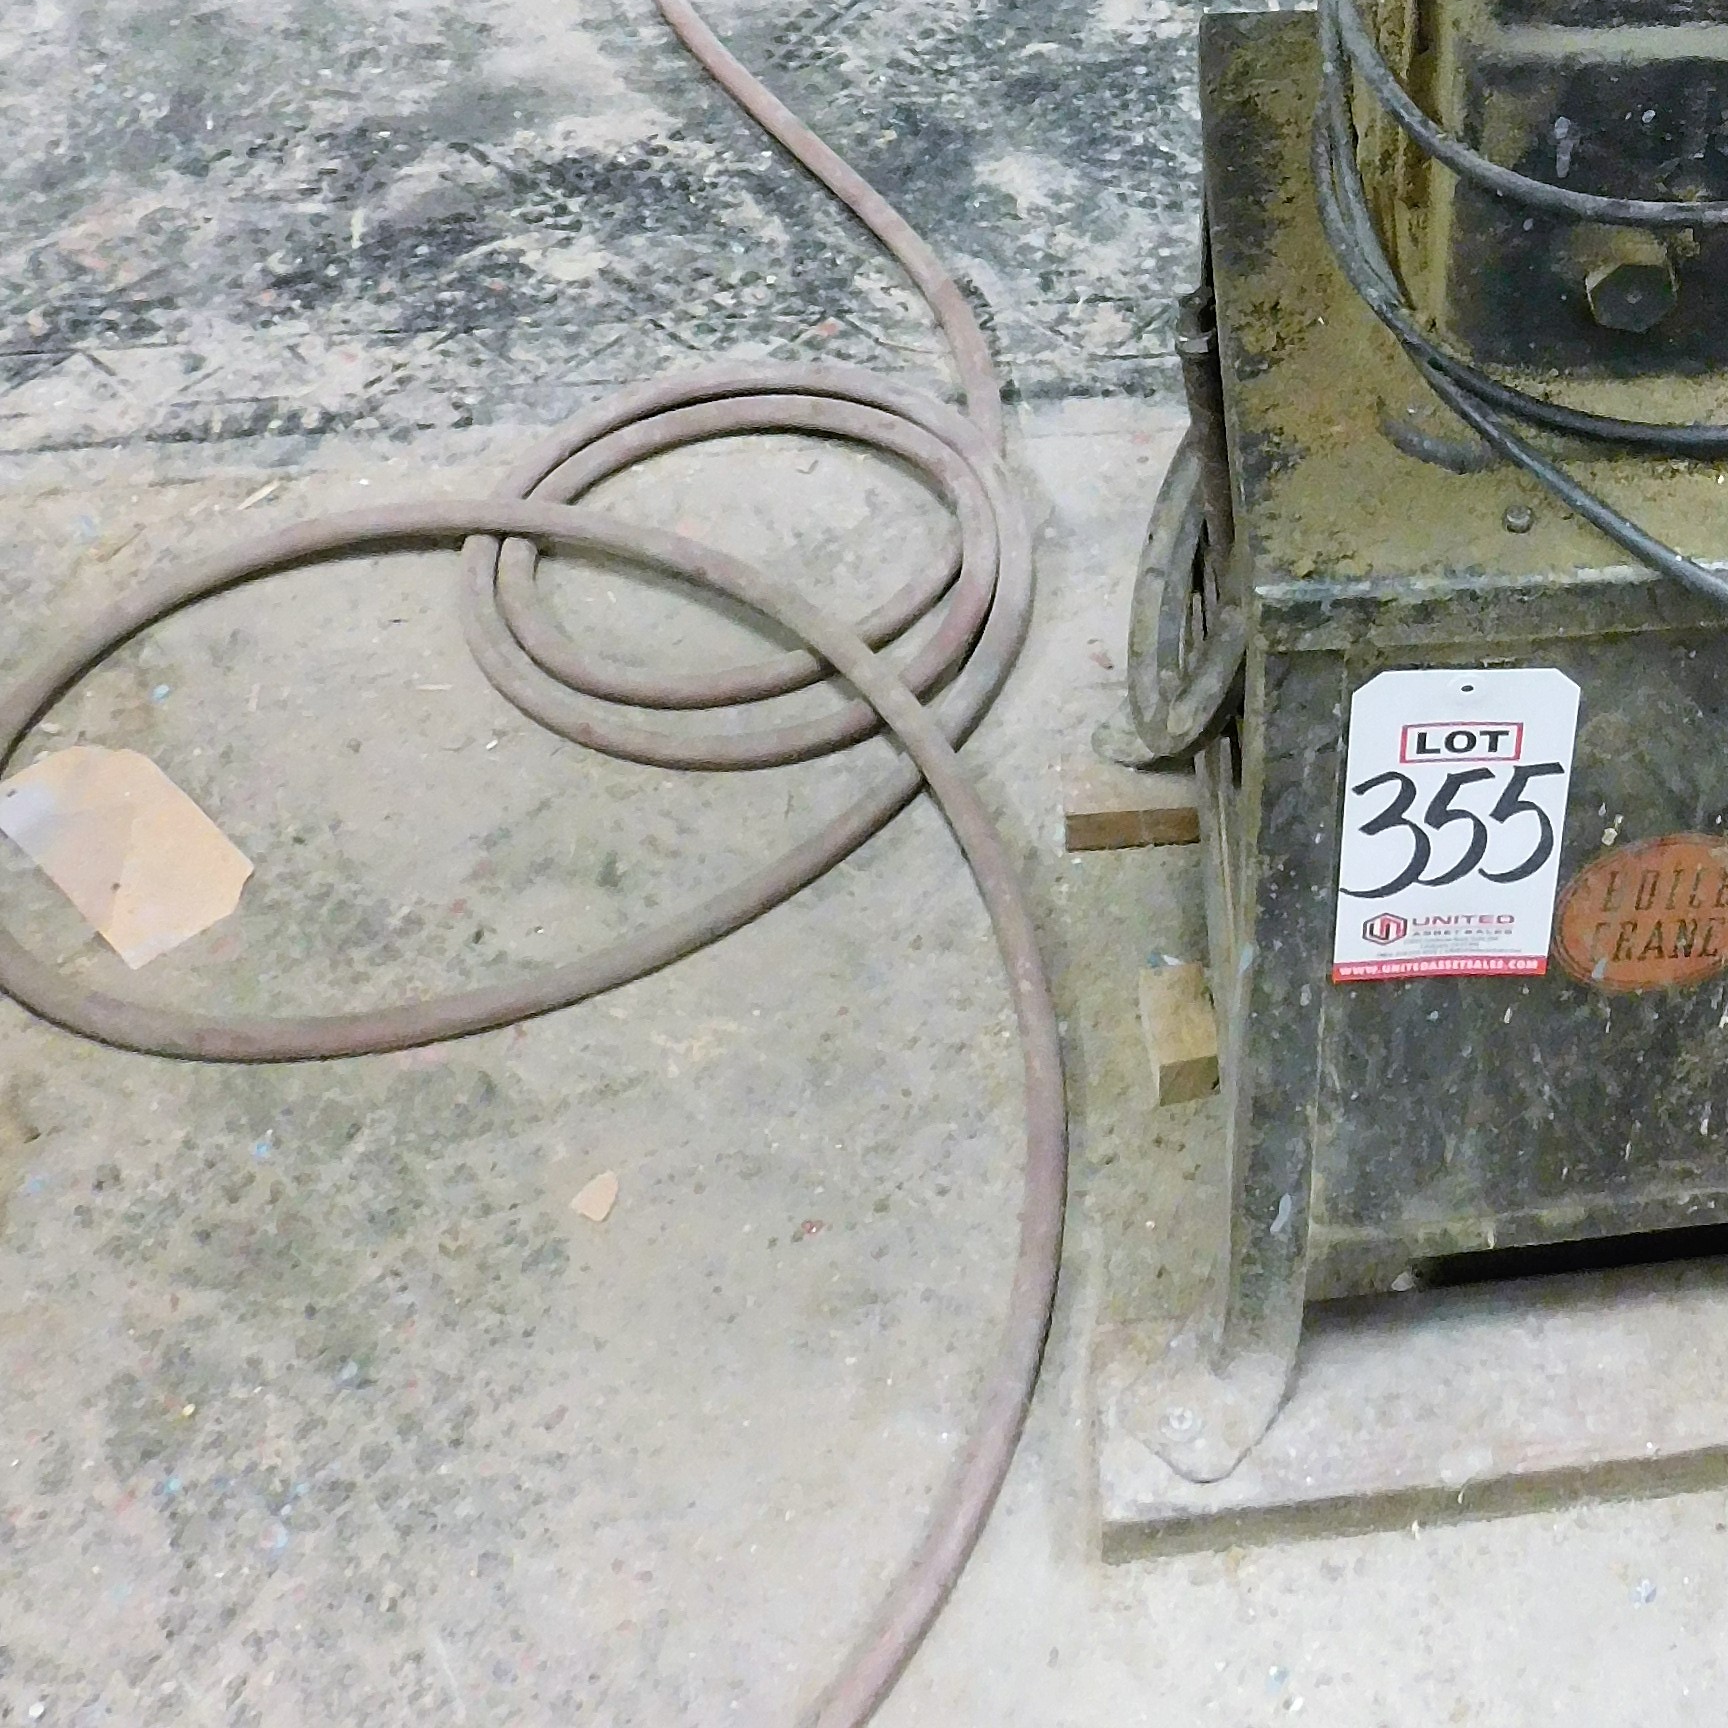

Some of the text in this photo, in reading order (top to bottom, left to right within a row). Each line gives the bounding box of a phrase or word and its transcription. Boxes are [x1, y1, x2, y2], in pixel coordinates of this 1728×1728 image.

[1415, 730, 1510, 755] LOT
[1338, 761, 1566, 899] 355
[1412, 914, 1515, 927] UNITED
